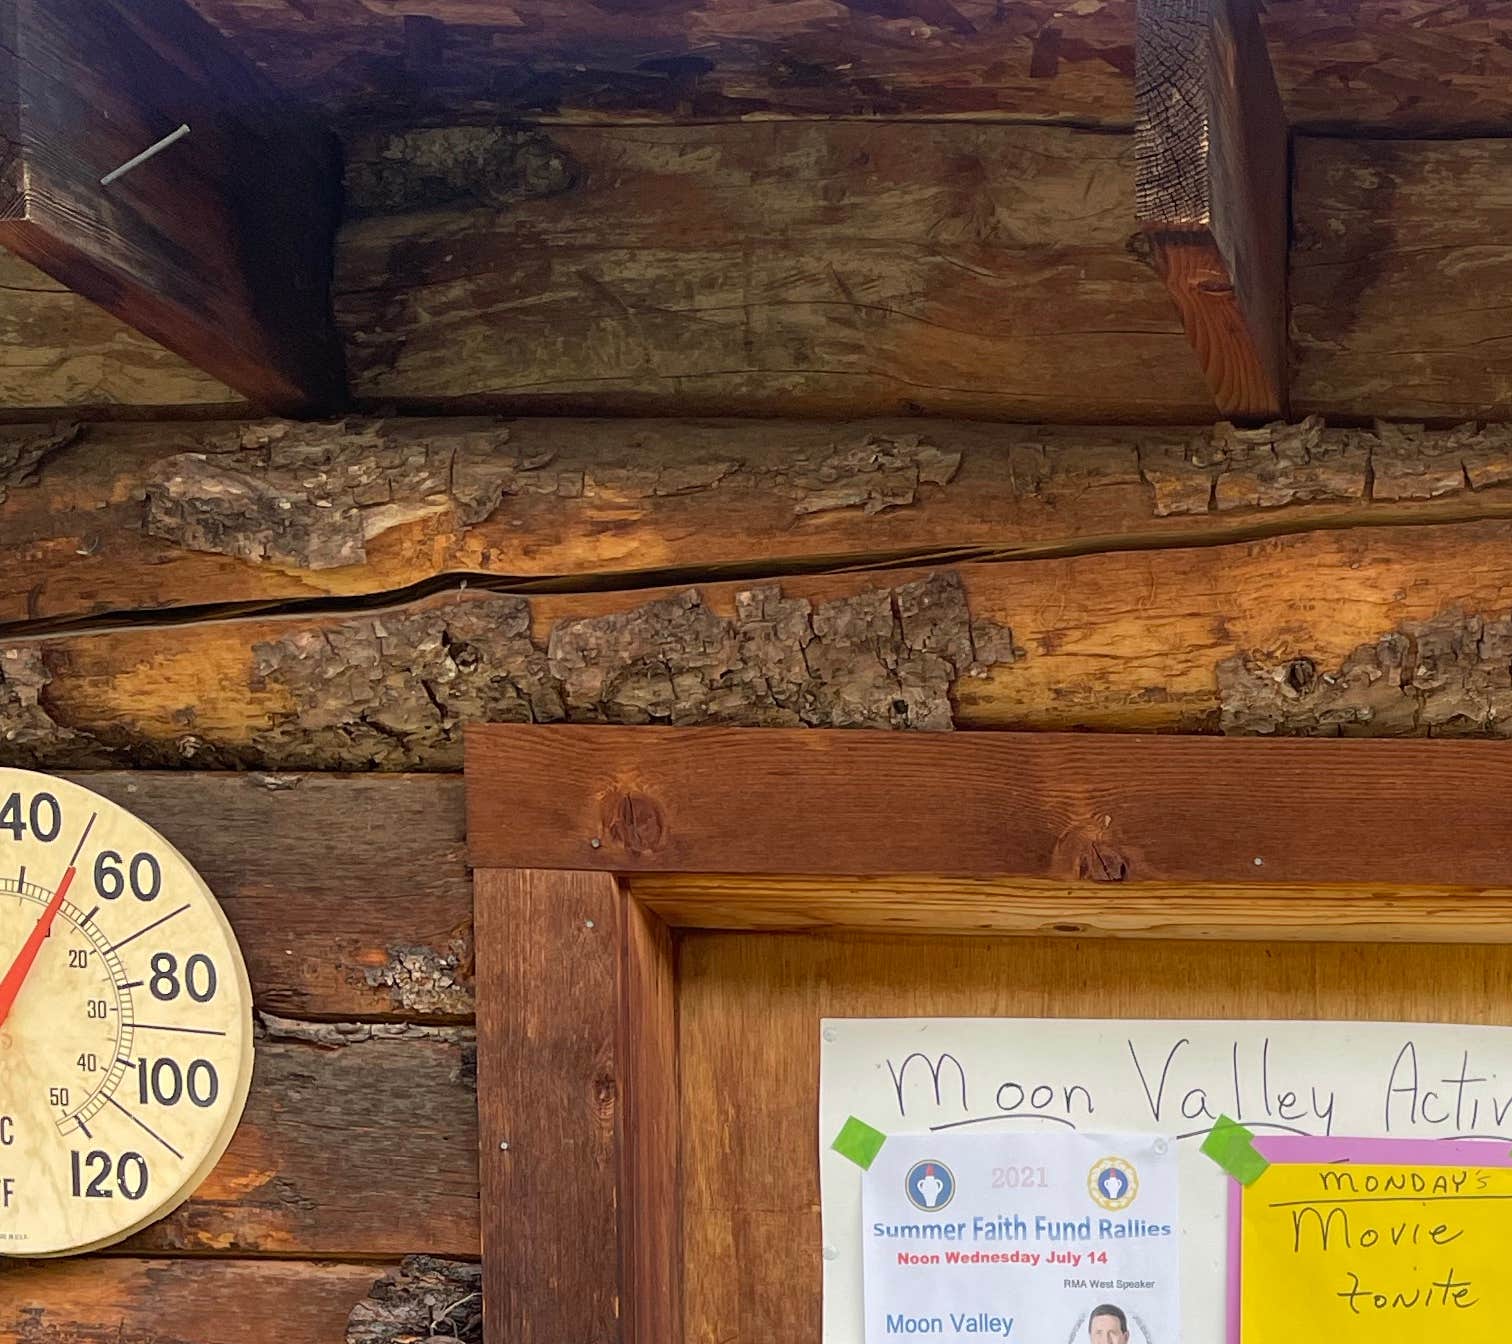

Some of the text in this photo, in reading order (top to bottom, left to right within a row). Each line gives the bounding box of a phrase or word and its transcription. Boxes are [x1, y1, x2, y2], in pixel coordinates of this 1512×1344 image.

[0, 792, 60, 841] 40
[94, 851, 161, 902] 60
[69, 950, 87, 969] 20
[150, 953, 217, 1003] 80
[87, 1001, 106, 1019] 30
[77, 1054, 97, 1072] 40
[138, 1058, 219, 1107] 100
[886, 1051, 1094, 1118] Moon
[1128, 1038, 1336, 1136] Valley
[49, 1088, 69, 1106] 50
[71, 1150, 148, 1200] 120
[992, 1166, 1048, 1189] 2021
[874, 1214, 1171, 1241] Summer Faith Fund Rallies
[1292, 1205, 1464, 1252] Movie
[898, 1251, 1108, 1267] Noon Wednesday July 14
[1116, 1280, 1154, 1290] Speaker
[886, 1313, 1013, 1337] Moon Valley
